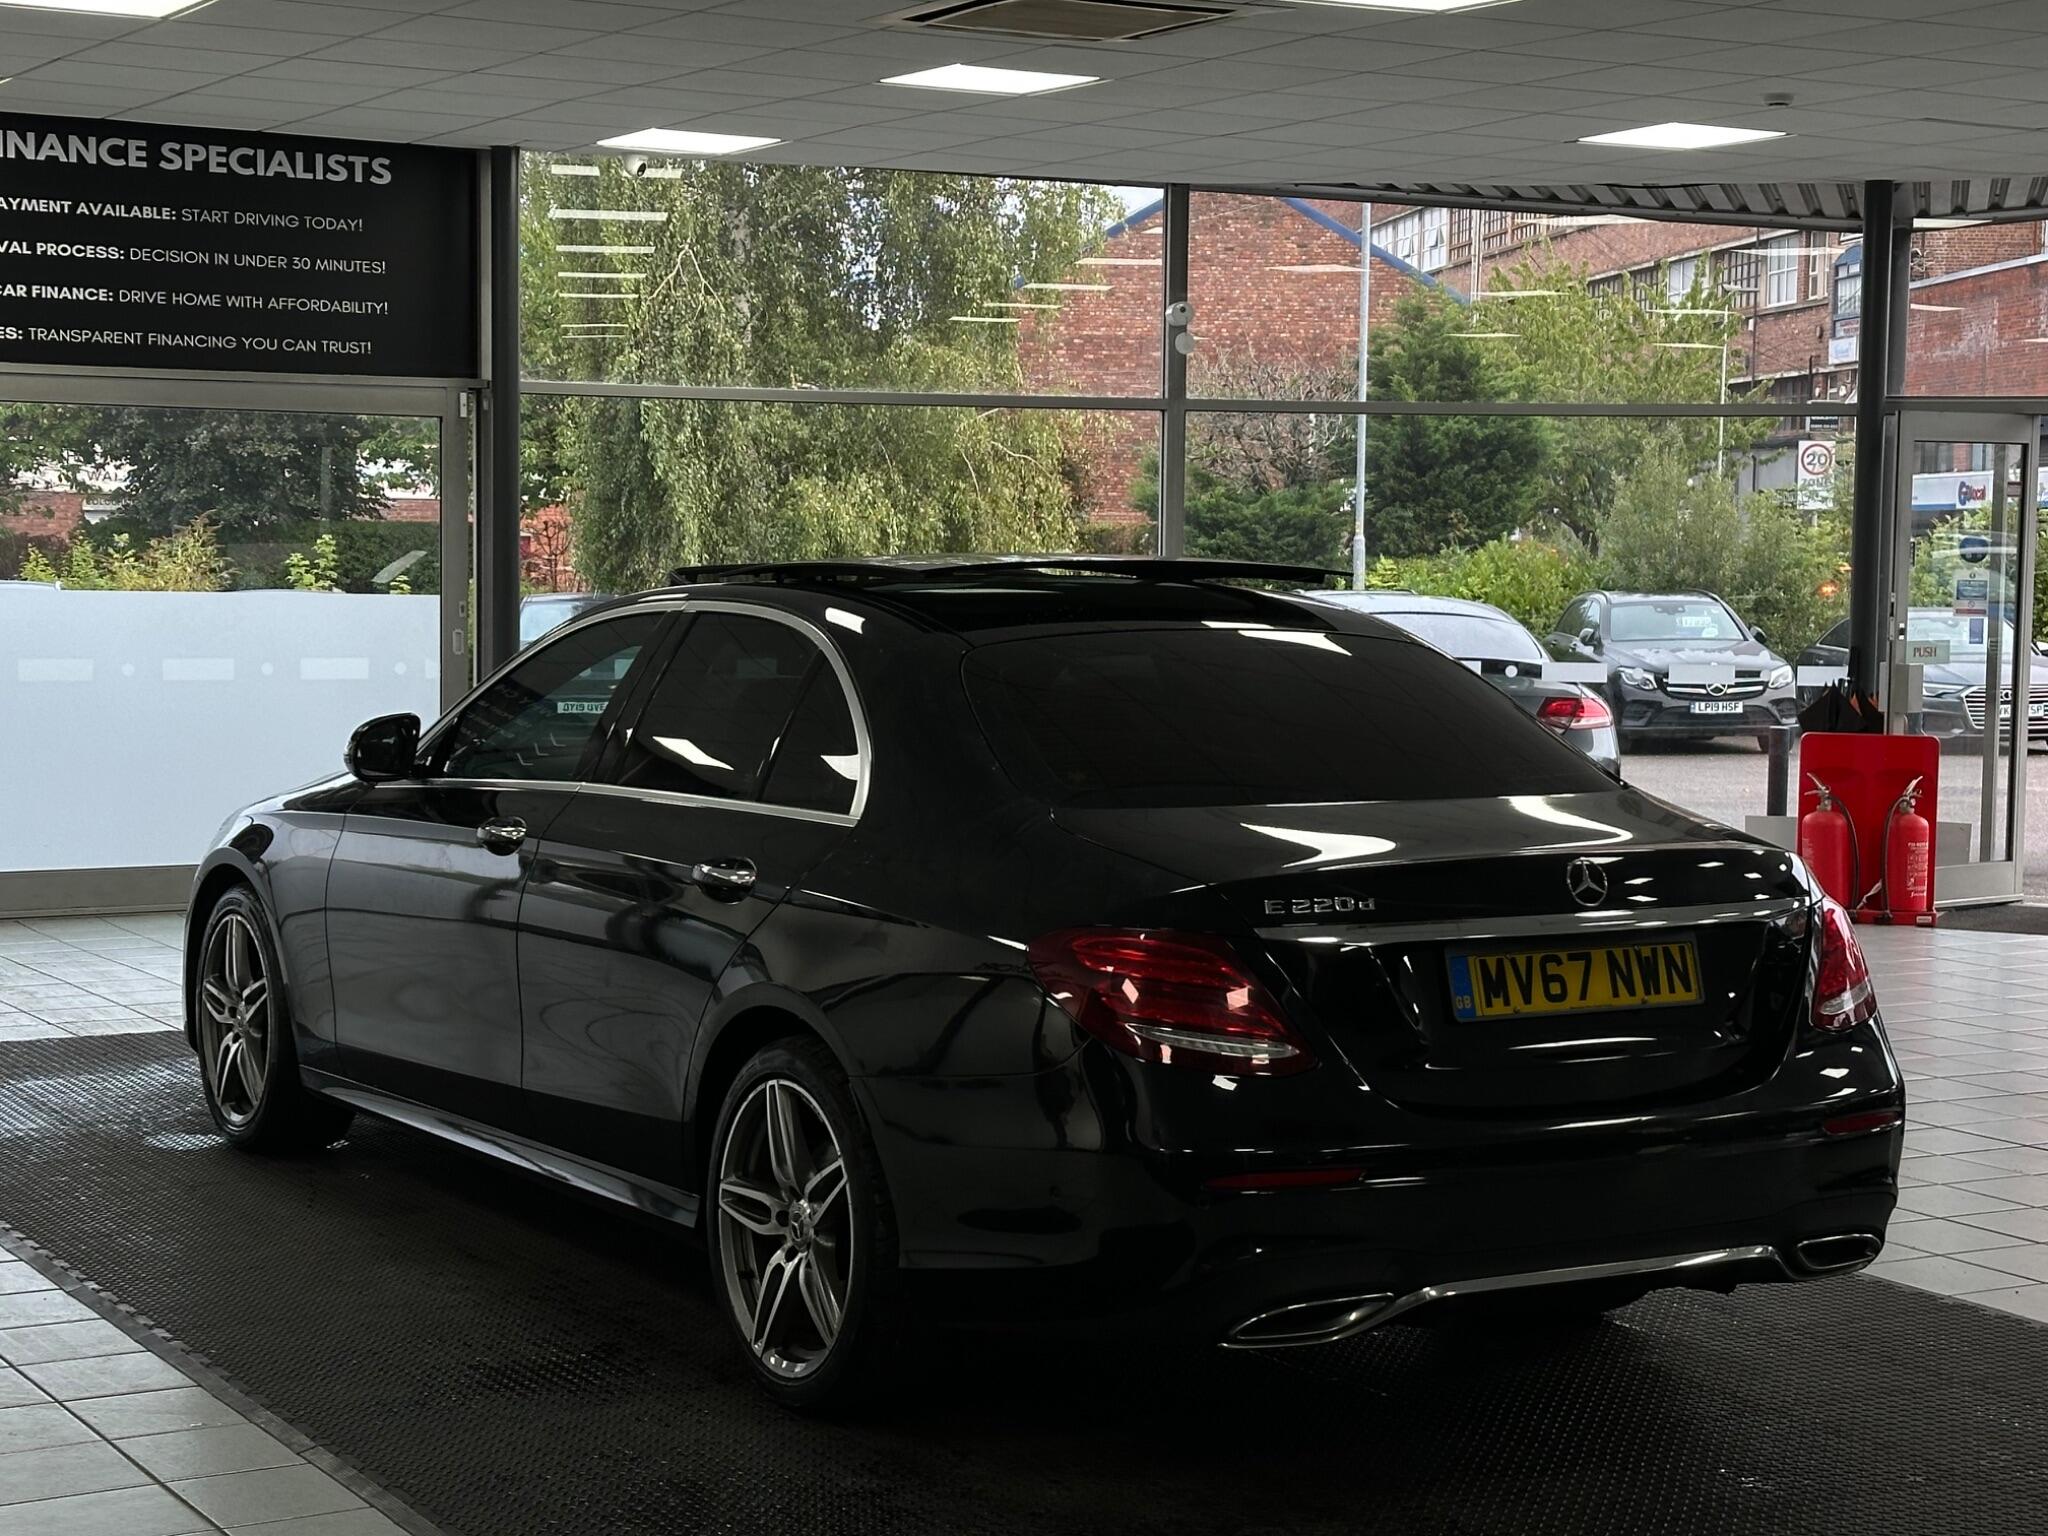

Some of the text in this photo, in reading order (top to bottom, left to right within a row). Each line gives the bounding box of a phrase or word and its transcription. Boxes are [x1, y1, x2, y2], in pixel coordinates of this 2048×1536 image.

[158, 142, 392, 185] SPECIALISTS
[75, 201, 176, 221] AVAILABLE:
[181, 208, 230, 224] START
[234, 212, 300, 228] DRIVING
[303, 215, 363, 232] TODAY!
[35, 242, 124, 260] PROCESS:
[129, 247, 209, 264] DECISION
[214, 252, 229, 265] IN
[233, 254, 289, 269] UNDER
[292, 256, 311, 270] 30
[314, 258, 387, 275] MINUTES!
[0, 283, 389, 315] AR FINANCE: DRIVE HOME WITH AFFORDABILITY!
[27, 327, 144, 346] TRANSPARENT
[148, 333, 237, 349] FINANCING
[241, 336, 278, 350] YOU
[282, 338, 317, 352] CAN
[321, 340, 372, 355] TRUST!
[1806, 452, 1828, 466] 20
[1913, 646, 1937, 658] PUSH
[1698, 702, 1720, 712] LP19
[1722, 702, 1740, 712] HSF
[1263, 898, 1286, 915] E
[1479, 944, 1693, 1009] MV67 NWN
[1455, 995, 1473, 1009] GB
